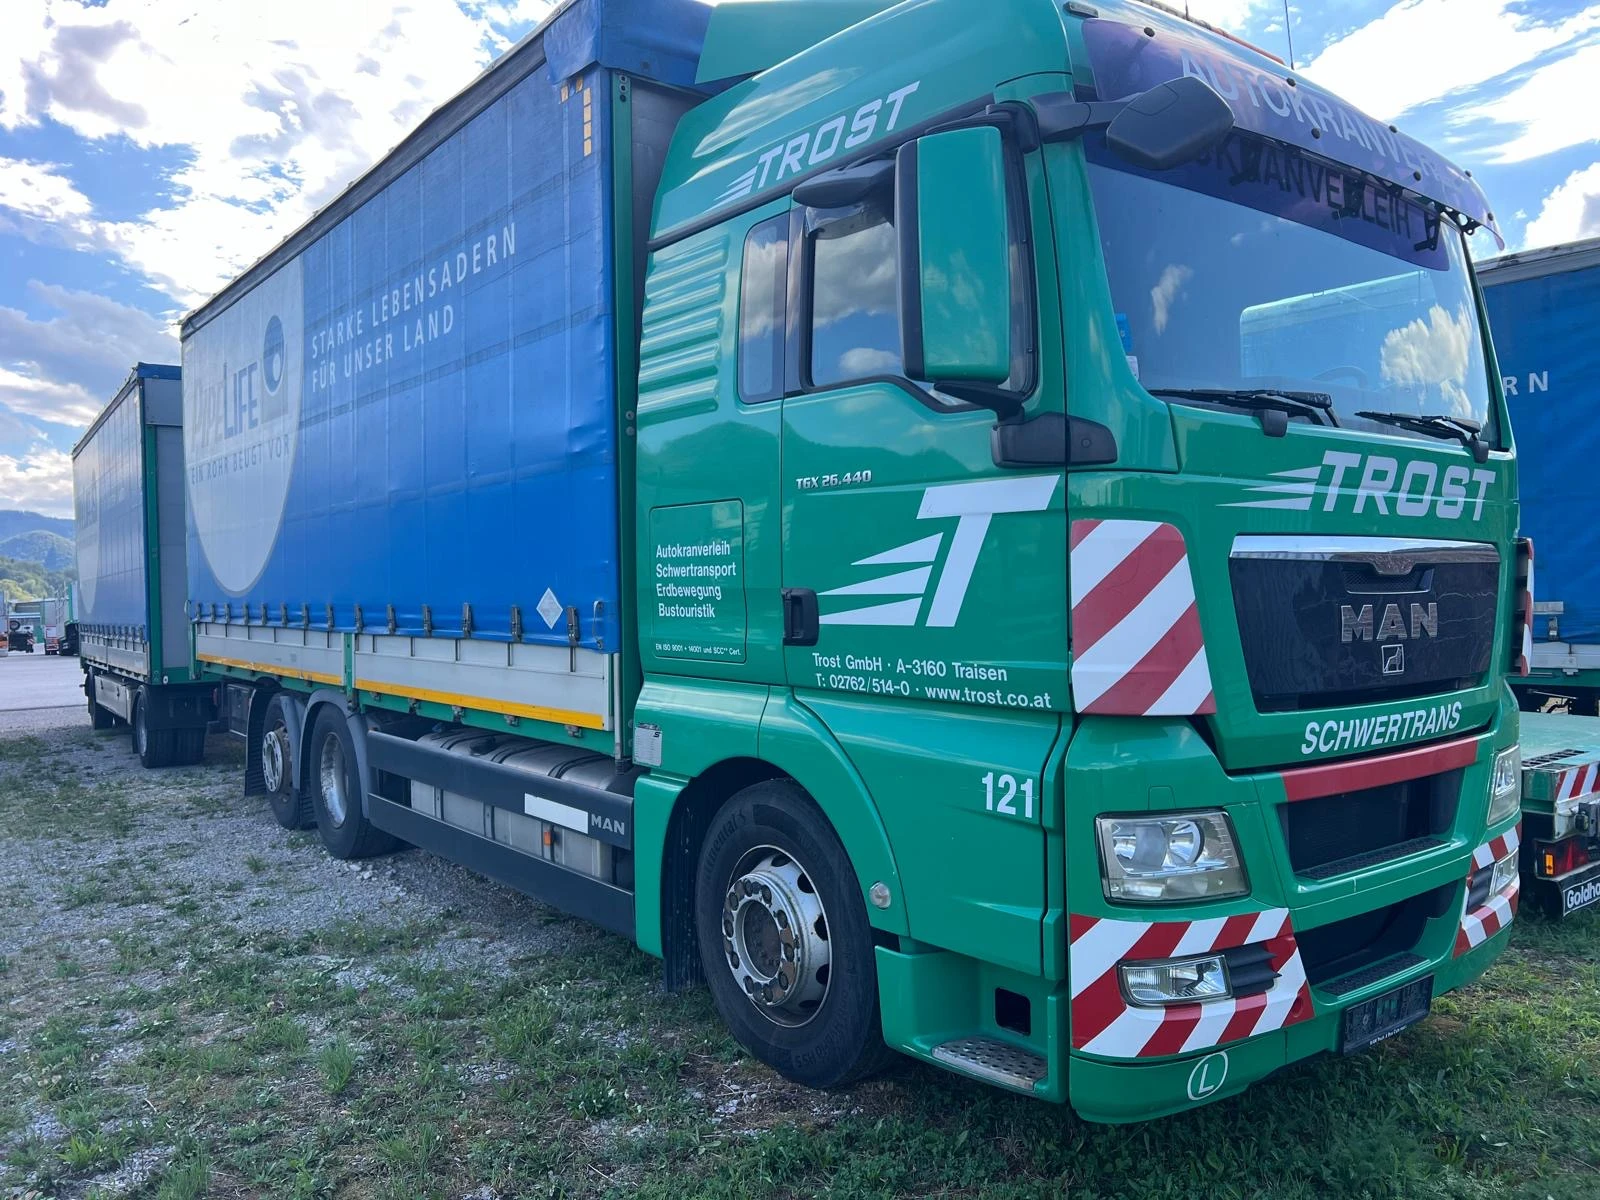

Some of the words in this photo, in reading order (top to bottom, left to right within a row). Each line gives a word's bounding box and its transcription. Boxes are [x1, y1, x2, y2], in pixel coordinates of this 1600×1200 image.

[757, 80, 920, 189] TROST
[312, 310, 363, 359] STARKE
[372, 222, 516, 327] LEBENSADERN
[313, 360, 336, 393] FÜR
[344, 333, 393, 378] UNSER
[404, 304, 454, 352] LAND
[207, 456, 228, 481] ROHR
[233, 443, 262, 472] BEUGT
[268, 434, 290, 459] VOR
[796, 476, 819, 489] TGX
[822, 470, 872, 487] 26.440
[1322, 450, 1497, 522] TROST
[655, 541, 731, 558] Autokranverleih
[655, 562, 737, 579] Schwertransport
[656, 583, 722, 600] Erdbewegung
[658, 603, 715, 618] Bustouristik
[1340, 602, 1439, 643] MAN
[671, 644, 683, 652] 9001
[703, 646, 712, 654] und
[812, 652, 840, 668] Trost
[845, 655, 882, 672] GmbH
[896, 657, 947, 677] A-3160
[952, 662, 1008, 681] Traisen
[816, 673, 826, 687] T:
[829, 674, 910, 696] 02762/514-0
[925, 685, 1053, 709] www.trost.co.at
[1301, 700, 1463, 755] SCHWERTRANS
[981, 771, 1034, 819] 121
[591, 813, 625, 836] MAN
[1197, 1063, 1215, 1095] L
